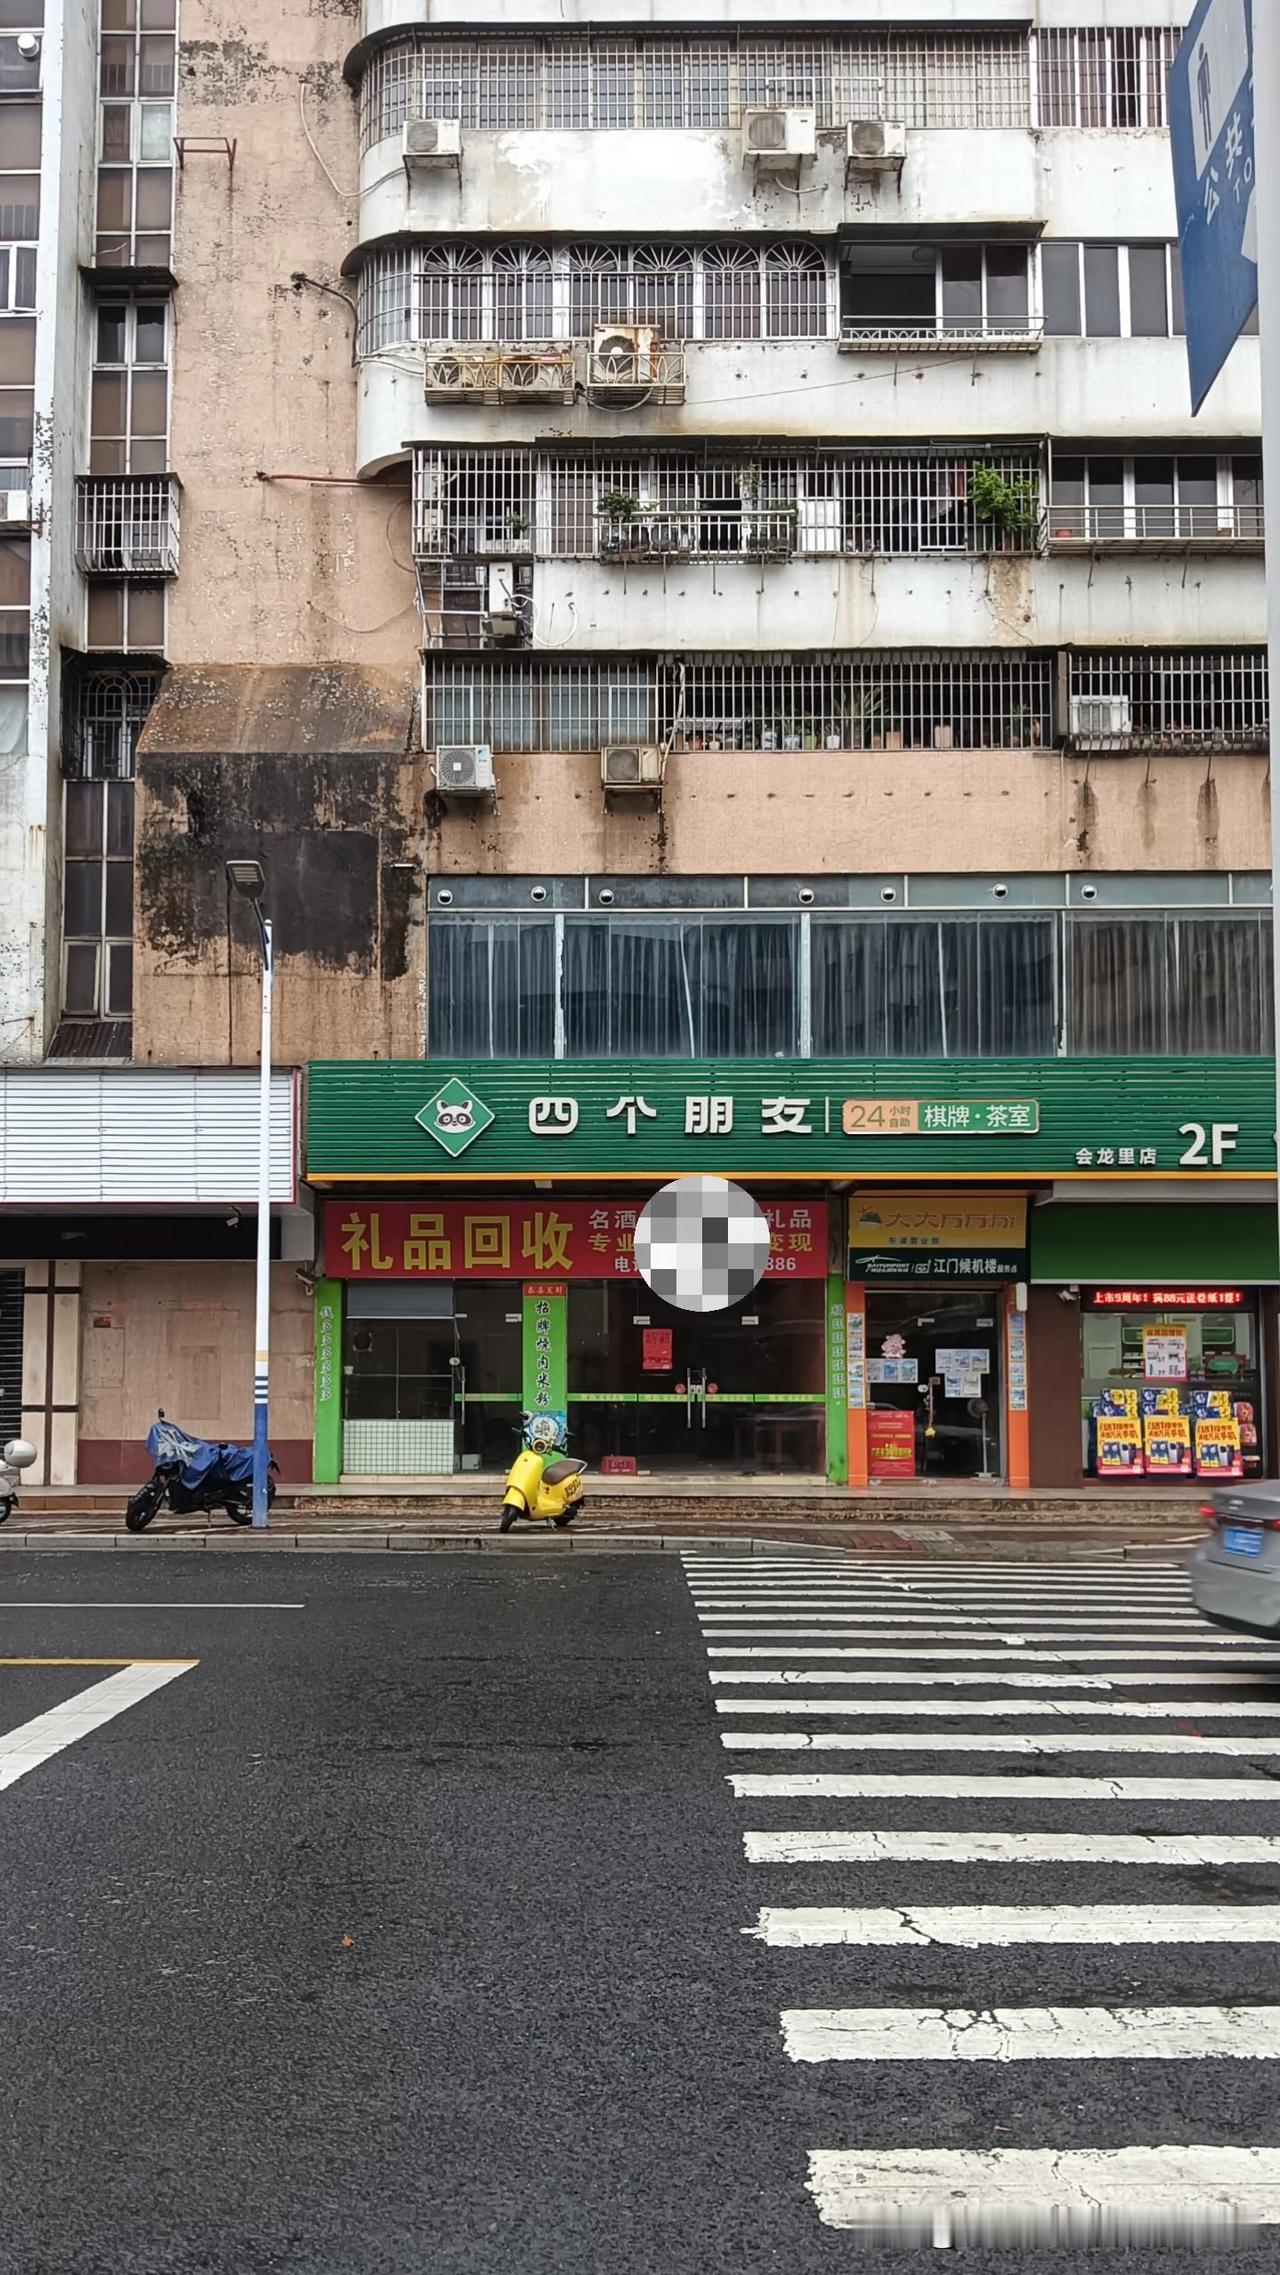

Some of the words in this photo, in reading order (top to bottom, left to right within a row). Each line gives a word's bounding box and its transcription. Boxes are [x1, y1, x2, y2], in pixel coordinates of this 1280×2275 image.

[528, 1096, 812, 1134] 四个朋友
[850, 1105, 885, 1128] 24
[890, 1106, 911, 1116] 小时
[890, 1118, 911, 1128] 自助
[1075, 1148, 1157, 1165] 会龙里店
[1178, 1123, 1239, 1166] 2F
[341, 1212, 574, 1271] 礼品回收
[535, 1301, 552, 1408] 招牌烧肉米粉
